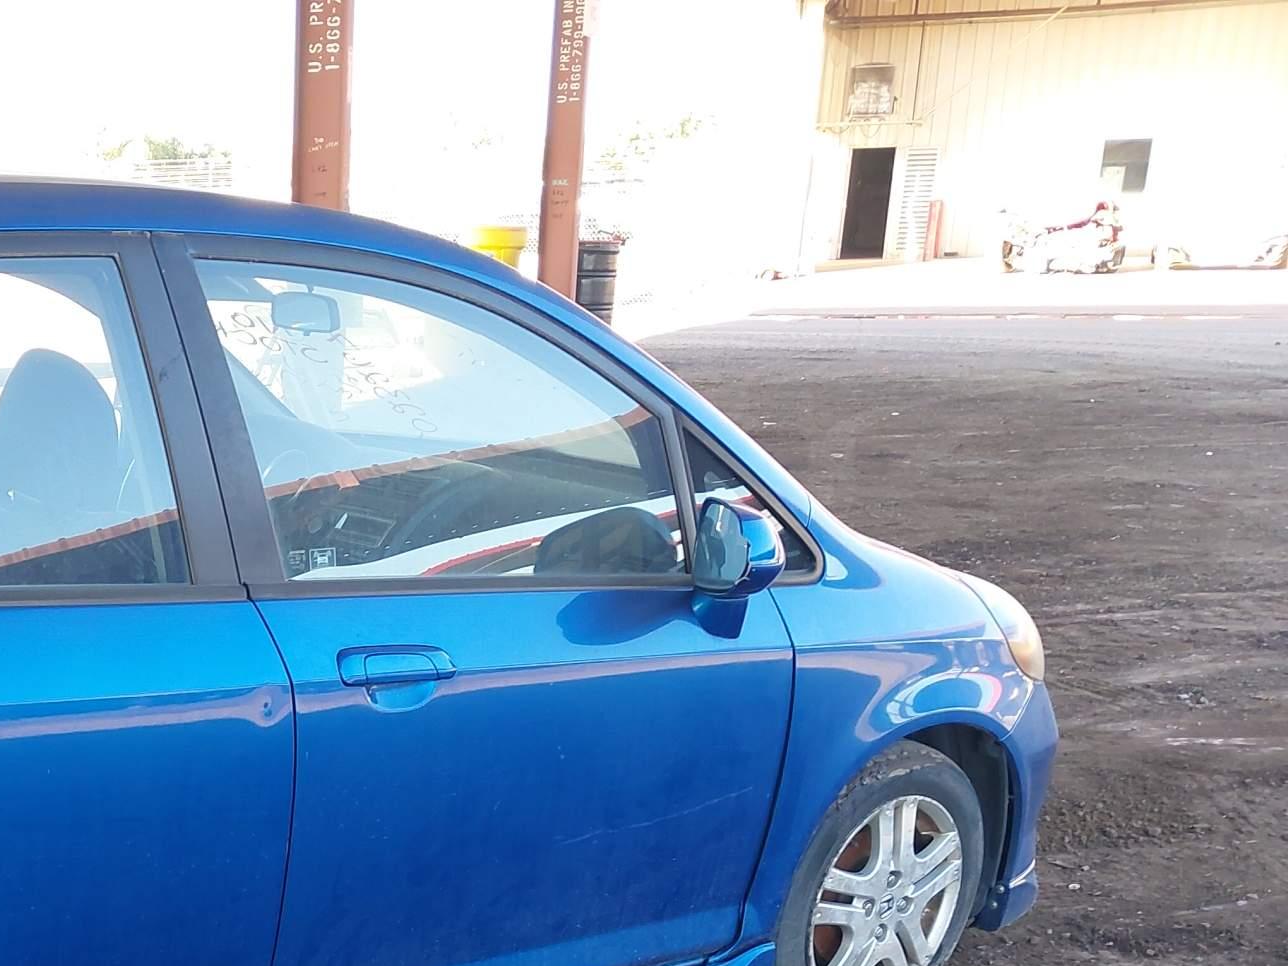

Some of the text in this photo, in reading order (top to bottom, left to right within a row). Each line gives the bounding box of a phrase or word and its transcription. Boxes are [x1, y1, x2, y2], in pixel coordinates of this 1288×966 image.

[307, 37, 323, 73] U.S.
[559, 19, 573, 71] PREFAB
[556, 78, 569, 104] U.S.
